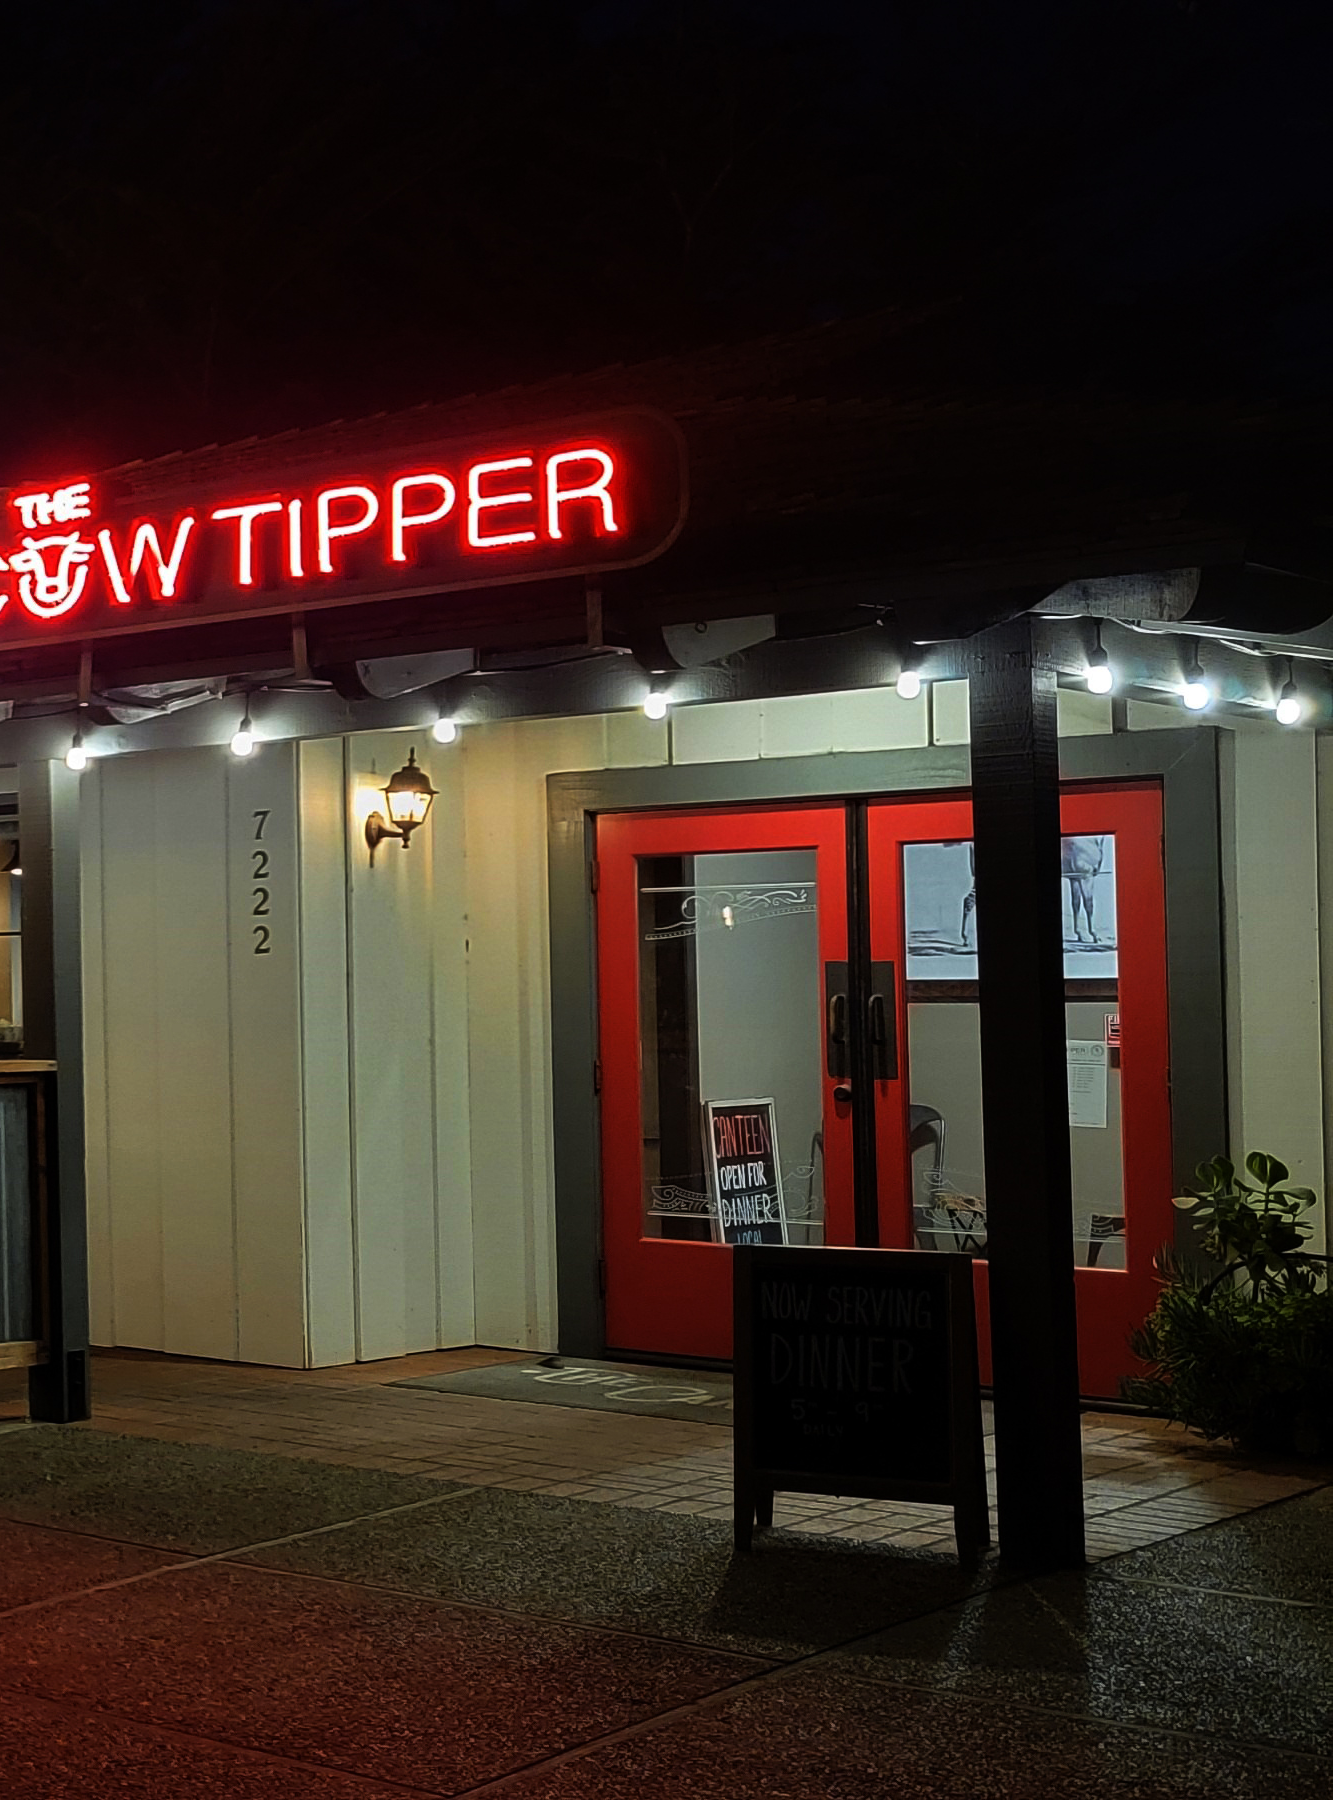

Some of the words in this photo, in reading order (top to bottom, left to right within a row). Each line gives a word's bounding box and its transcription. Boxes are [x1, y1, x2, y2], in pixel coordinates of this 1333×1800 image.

[13, 483, 91, 529] THE
[211, 447, 619, 587] TIPPER
[251, 809, 272, 955] 7222
[713, 1114, 770, 1158] CANTEEN
[720, 1164, 746, 1191] OPEN
[747, 1161, 767, 1188] FOR
[722, 1194, 773, 1227] DINNER
[761, 1281, 812, 1321] NOW
[824, 1285, 932, 1329] SERVING
[770, 1332, 915, 1395] DINNER
